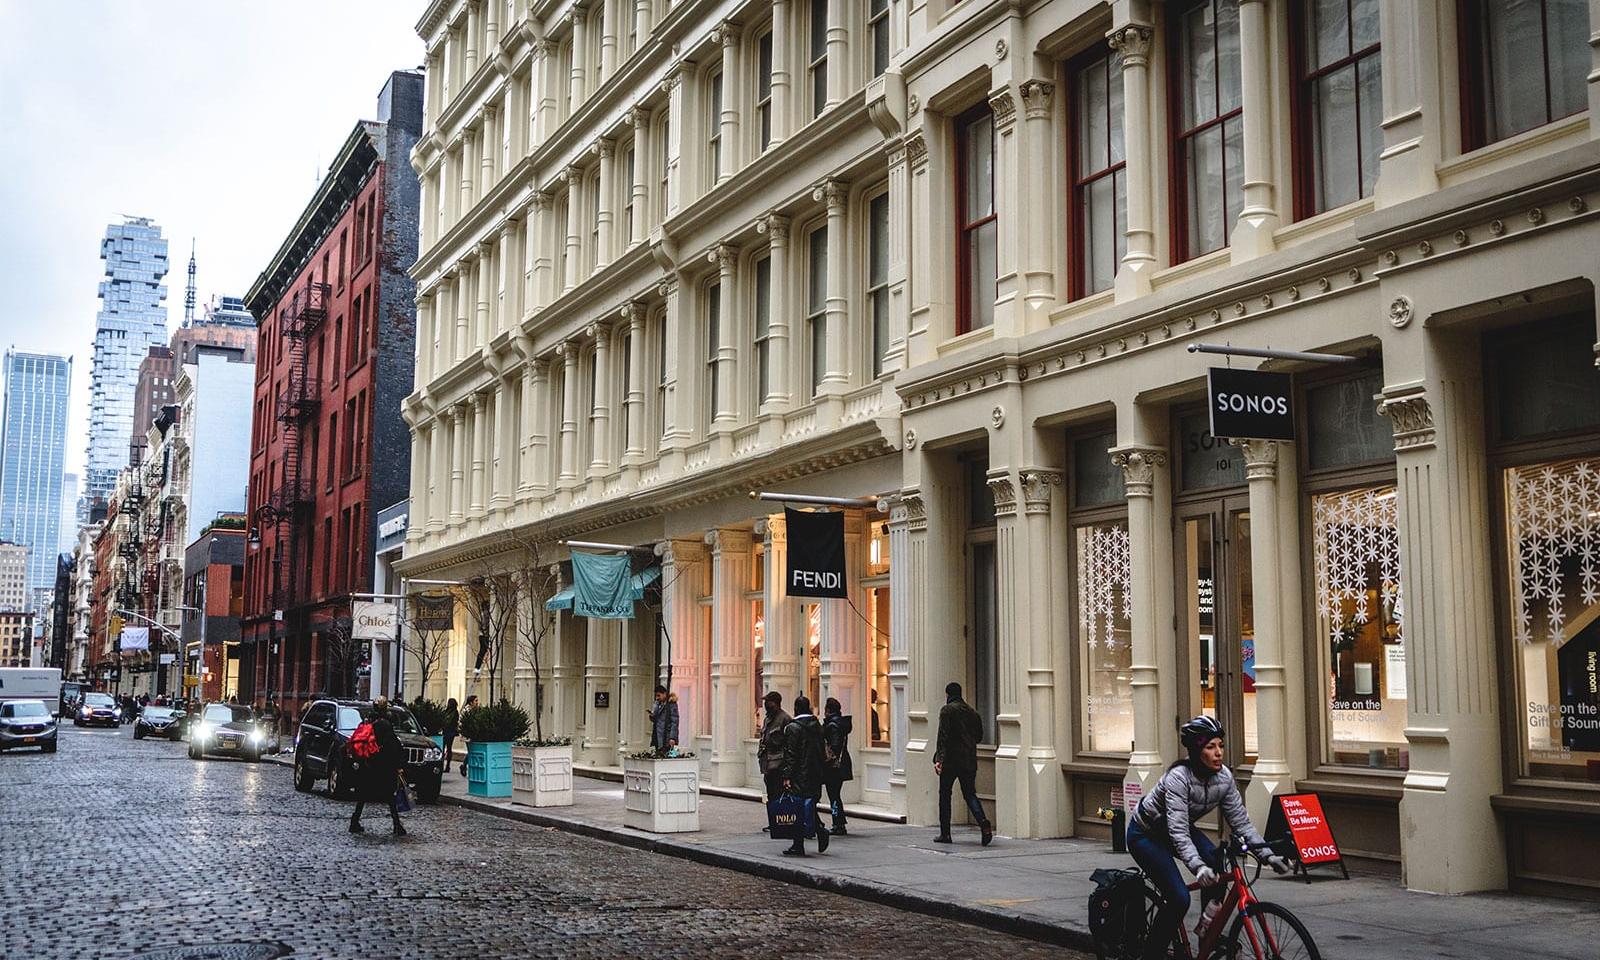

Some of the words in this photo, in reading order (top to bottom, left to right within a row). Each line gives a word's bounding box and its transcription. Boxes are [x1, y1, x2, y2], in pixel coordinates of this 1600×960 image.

[1217, 392, 1288, 415] SONOS
[793, 569, 841, 589] FENDI
[358, 615, 391, 627] Chloé
[1589, 672, 1597, 693] room
[1329, 700, 1350, 709] Save
[1352, 701, 1364, 709] on
[1365, 699, 1381, 709] the
[1529, 701, 1557, 713] Save
[1560, 705, 1575, 714] on
[1577, 702, 1598, 714] the
[1529, 715, 1550, 728] Gift
[1553, 715, 1565, 728] of
[1568, 716, 1600, 729] Soun
[1283, 799, 1302, 808] Save.
[1287, 807, 1309, 816] Listen.
[775, 813, 797, 823] POLO
[1290, 817, 1300, 825] Be
[1300, 816, 1321, 825] Merry.
[1301, 845, 1337, 858] SONOS
